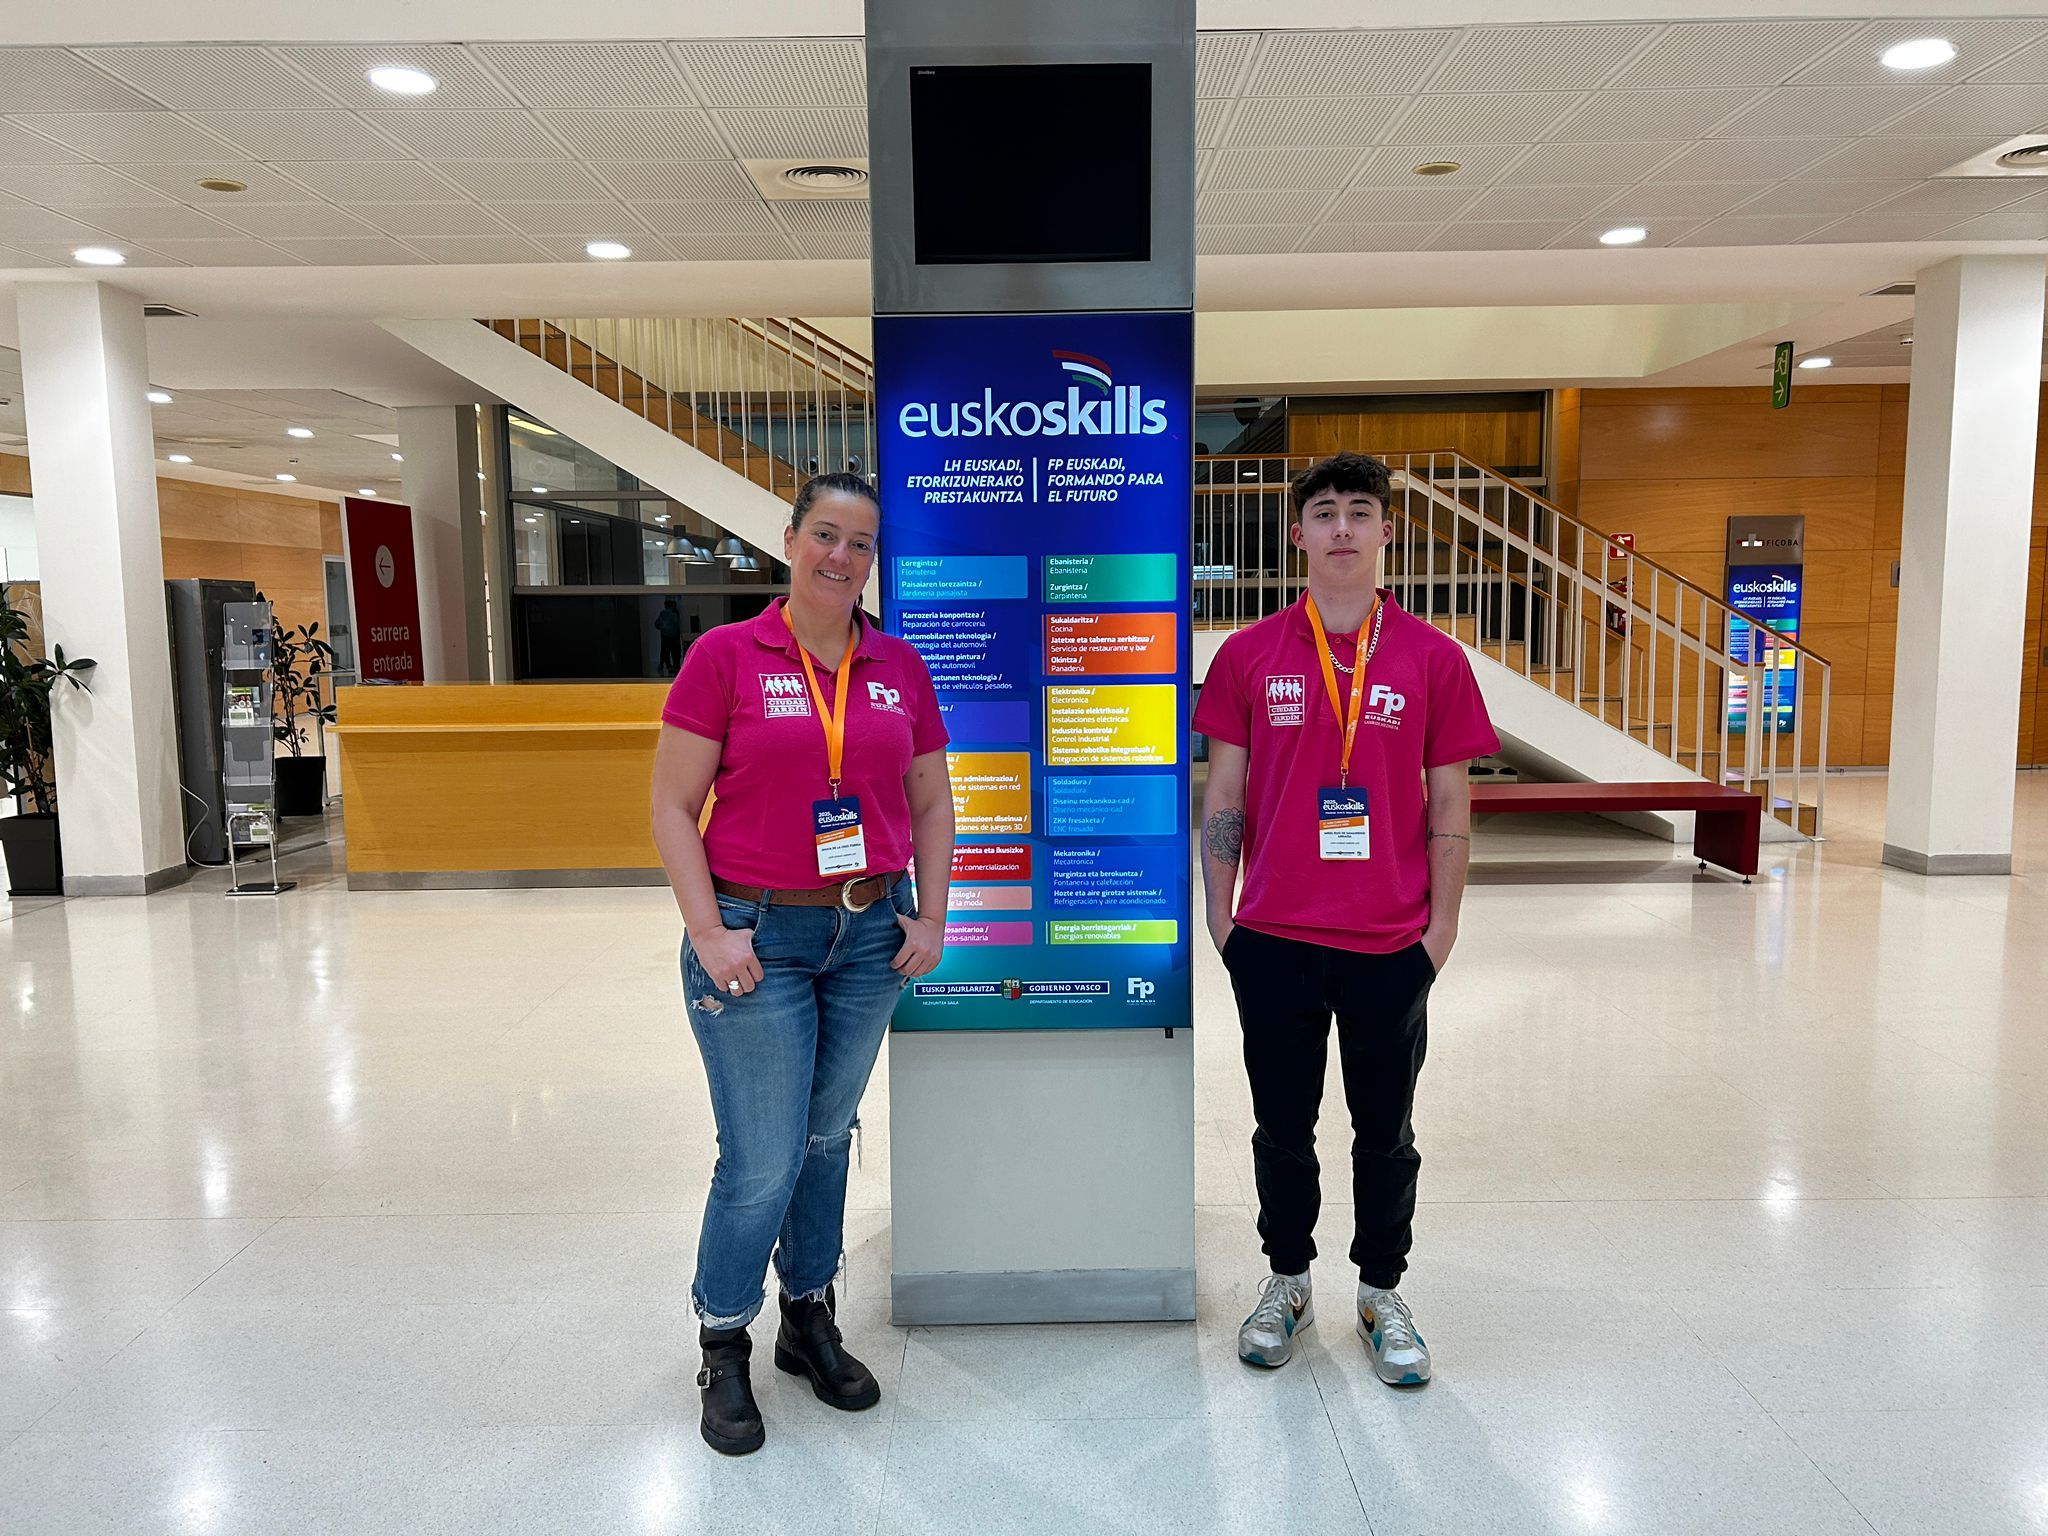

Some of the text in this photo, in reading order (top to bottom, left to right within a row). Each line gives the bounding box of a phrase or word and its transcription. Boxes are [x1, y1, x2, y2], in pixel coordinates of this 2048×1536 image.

[900, 386, 1167, 437] euskoskills
[944, 460, 1023, 473] LH EUSKADI,
[1048, 458, 1125, 471] FP EUSKADI,
[907, 476, 1024, 488] ETORKIZUNERAKO
[1048, 473, 1163, 486] FORMANDO PARA
[924, 491, 1023, 503] PRESTAKUNTZA
[1048, 490, 1117, 502] EL FUTURO
[902, 560, 937, 568] Loregintza
[1733, 580, 1796, 592] euskoskills
[940, 612, 979, 620] konpontzea
[371, 626, 409, 642] sarrera
[956, 632, 991, 641] teknologia
[373, 651, 412, 672] entrada
[962, 674, 997, 682] teknologia
[867, 682, 900, 705] Fp
[1369, 685, 1405, 715] Fp
[1365, 715, 1400, 725] EUSKADI
[1323, 802, 1364, 810] euskoskills
[818, 811, 857, 823] euskoskills
[991, 824, 1012, 832] juegos
[954, 847, 982, 855] painketa
[1055, 924, 1080, 932] Energia
[1128, 978, 1154, 998] Fp
